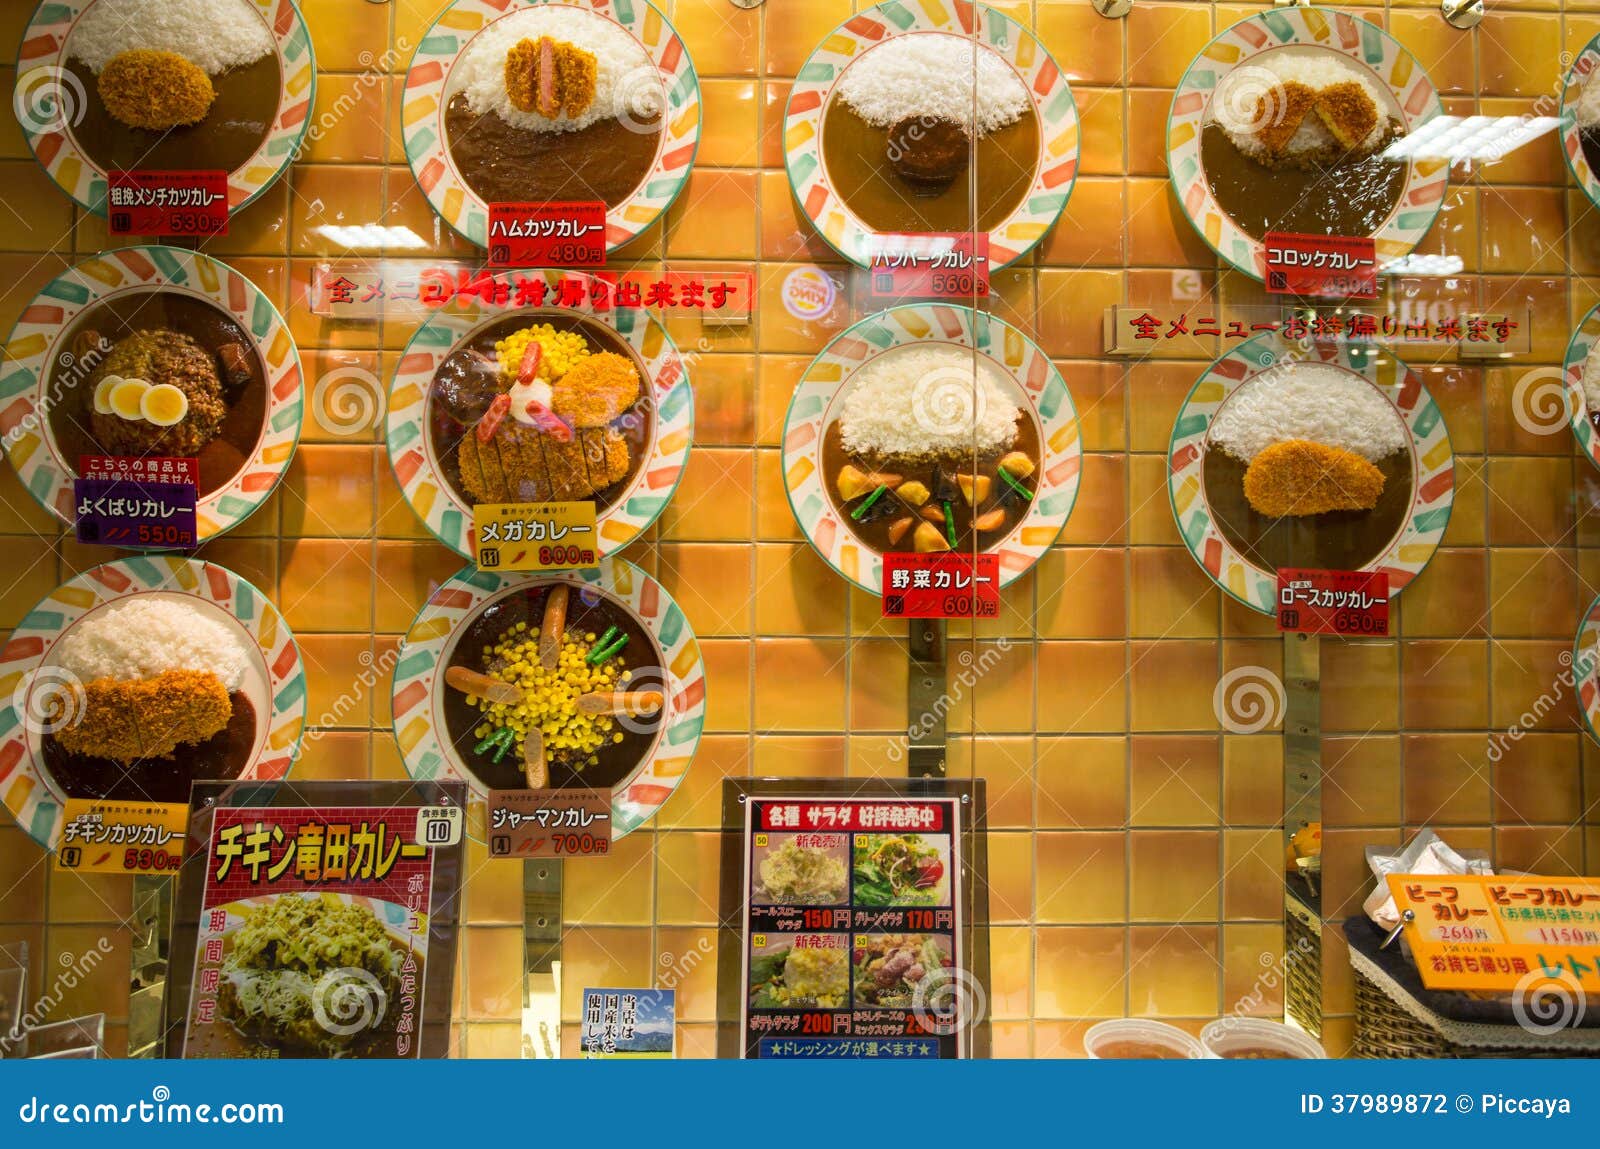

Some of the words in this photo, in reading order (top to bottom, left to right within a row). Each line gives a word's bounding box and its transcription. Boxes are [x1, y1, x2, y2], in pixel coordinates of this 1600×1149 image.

[111, 187, 225, 206] 粗挽メンチカツカレー
[490, 219, 603, 237] ハムカツカレー
[550, 245, 601, 262] 480円
[875, 248, 985, 269] ハンバーグカレー
[1268, 248, 1374, 269] コロッケカレー
[324, 276, 738, 309] 全メニューお持帰り出来ます
[1129, 313, 1519, 343] 全メニューお持帰り出来ます
[90, 459, 188, 473] こちらの商品は
[78, 497, 192, 518] よくばりカレー
[139, 525, 192, 543] 550円
[481, 520, 591, 542] メガカレー
[539, 546, 595, 565] 800円
[892, 570, 991, 588] 野菜カレー
[1282, 588, 1387, 609] ロースカツカレー
[493, 808, 608, 828] ジャーマンカレー
[769, 806, 800, 827] 各種
[807, 806, 852, 827] サラダ
[859, 806, 934, 827] 好評発売中
[65, 822, 186, 845] チキンカツカレー
[430, 823, 447, 840] 10
[216, 820, 427, 883] チキン竜田カレー
[552, 834, 608, 853] 700円
[1406, 885, 1458, 902] ビーフ
[1489, 886, 1600, 906] ビーフカレー
[804, 909, 851, 928] 150円
[907, 910, 953, 929] 170円
[1432, 903, 1488, 921] カレー
[1439, 925, 1488, 939] 260円
[196, 910, 226, 1024] 期間限定
[1537, 953, 1600, 979] レト
[587, 994, 602, 1058] 使用して
[603, 994, 619, 1054] 国産米を
[622, 994, 636, 1039] 当店は
[802, 1013, 851, 1033] 200円
